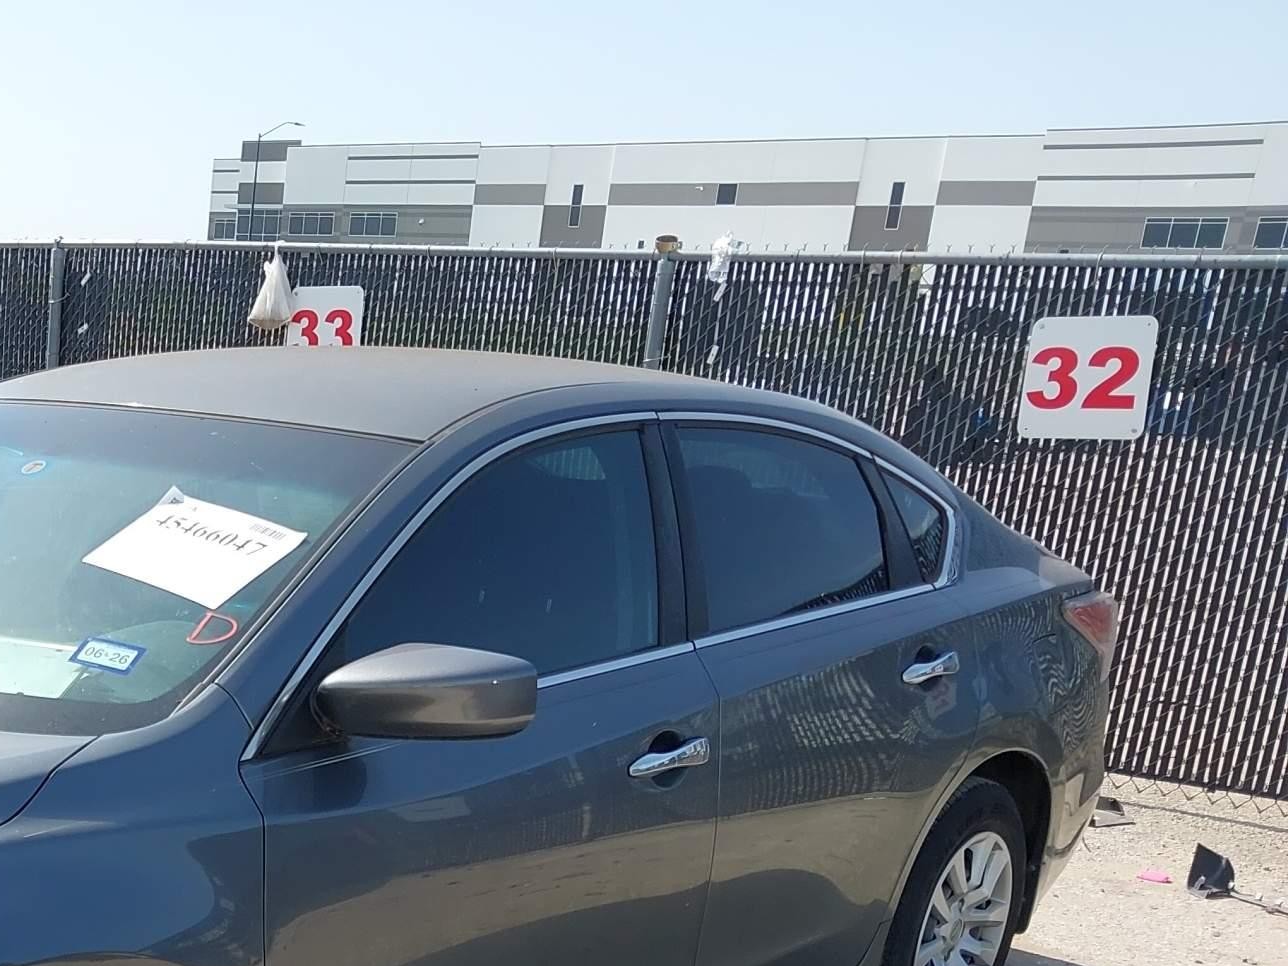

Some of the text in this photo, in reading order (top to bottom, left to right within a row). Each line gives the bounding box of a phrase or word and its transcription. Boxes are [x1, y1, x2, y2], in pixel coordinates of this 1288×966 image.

[291, 308, 354, 346] 33
[1025, 345, 1141, 411] 32
[156, 514, 268, 556] 45466047
[185, 611, 238, 645] D
